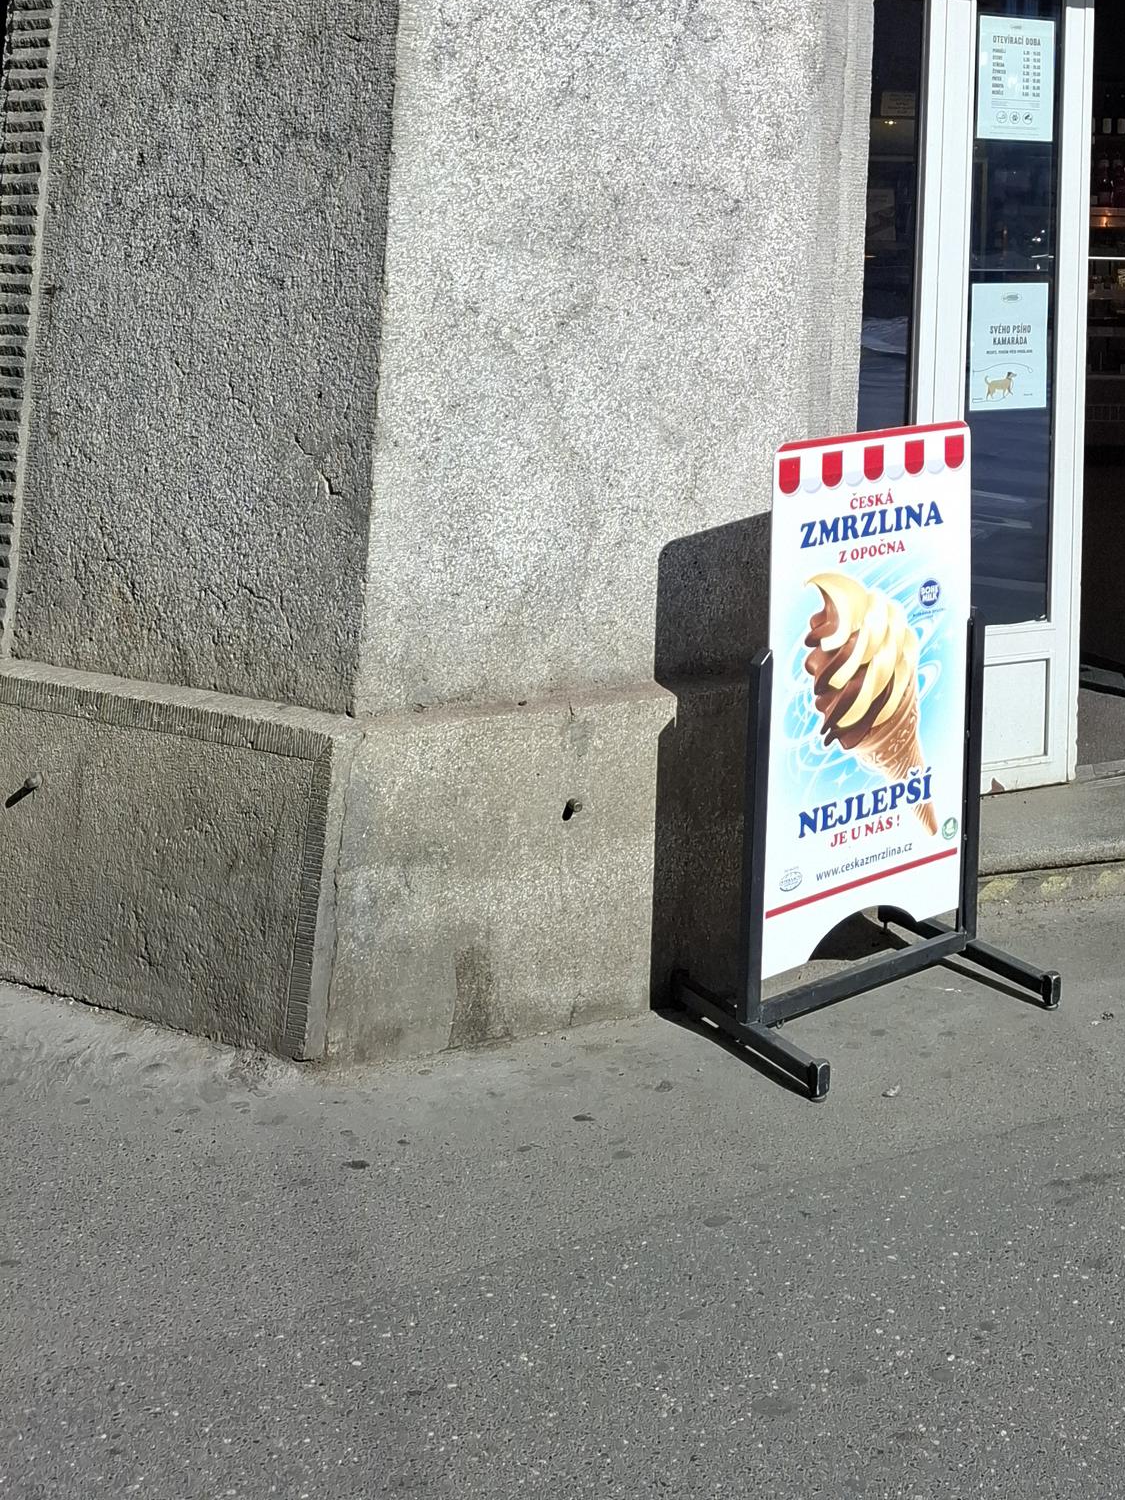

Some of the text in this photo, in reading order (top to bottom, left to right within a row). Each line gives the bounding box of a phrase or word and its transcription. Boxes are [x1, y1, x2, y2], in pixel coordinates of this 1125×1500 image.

[849, 488, 894, 510] ČESKÁ
[800, 500, 944, 549] ZMRZLINA
[838, 539, 906, 564] Z OPOČNA
[798, 766, 933, 839] NEJLEPŠÍ
[830, 830, 848, 848] JE
[851, 826, 861, 840] U
[815, 842, 913, 882] www.ceskazmrzlina.cz
